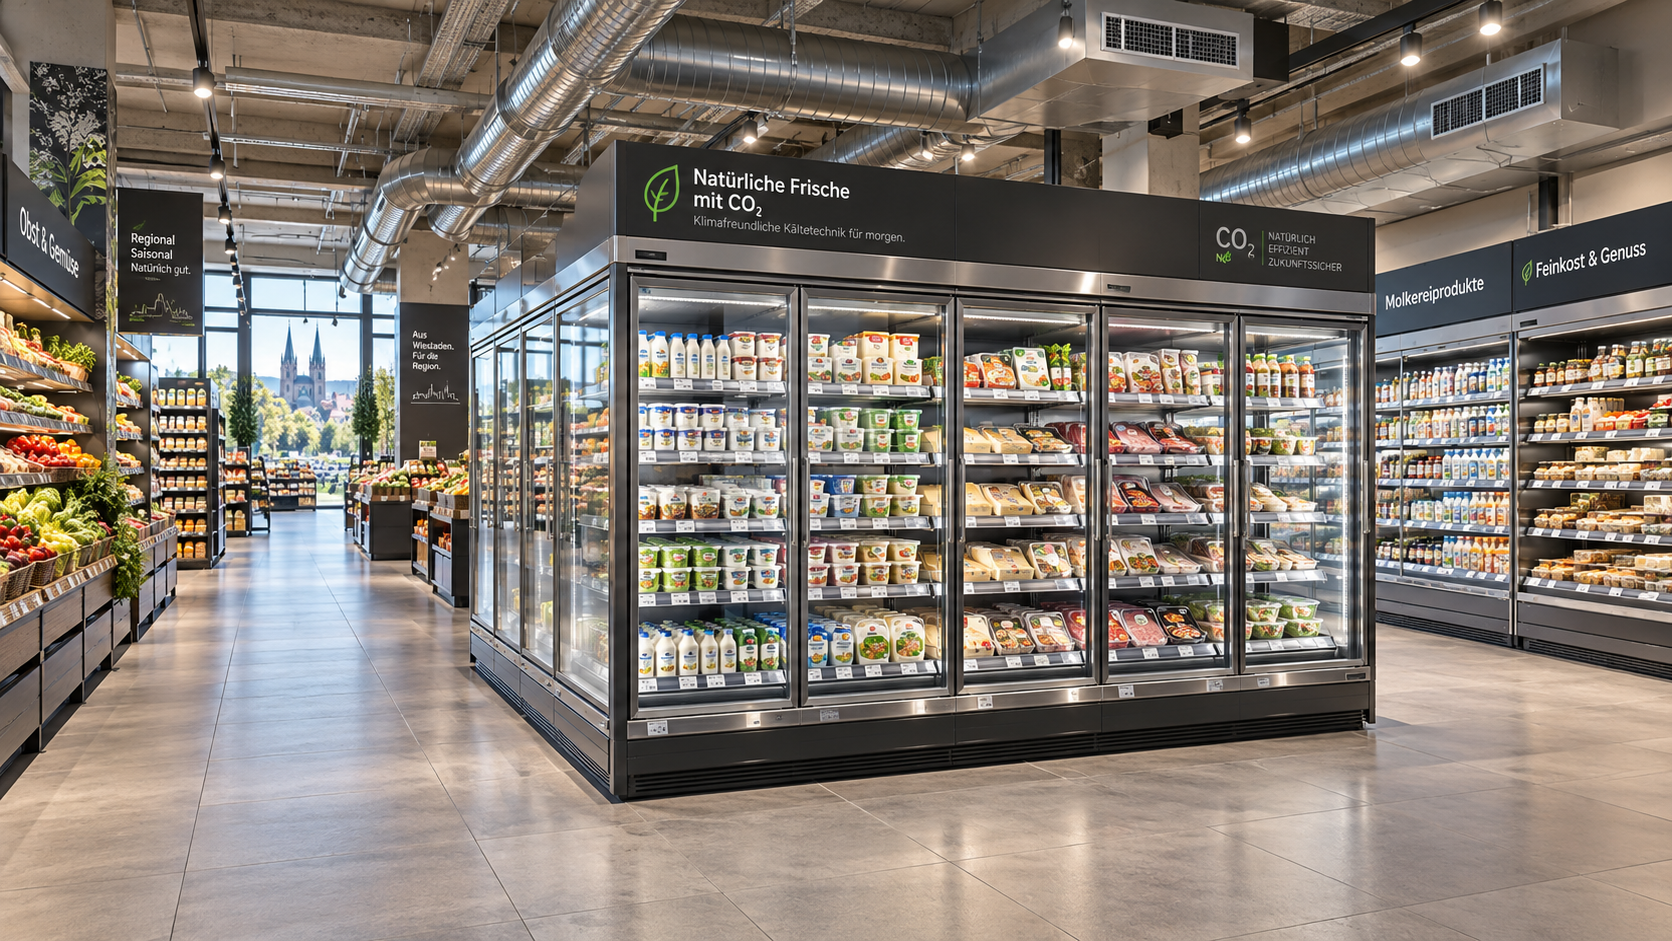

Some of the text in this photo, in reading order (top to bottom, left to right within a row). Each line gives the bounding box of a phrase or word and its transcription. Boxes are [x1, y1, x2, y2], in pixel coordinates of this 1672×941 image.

[693, 168, 850, 199] Natürliche Frische
[693, 192, 723, 209] mit
[20, 206, 40, 248] Obst
[41, 226, 48, 255] &
[693, 215, 905, 244] Klimafreundliche Kältetechnik für morgen.
[1268, 231, 1316, 244] NATÜRLICH
[131, 232, 175, 247] Regional
[130, 247, 173, 260] Saisonal
[1535, 242, 1646, 278] Feinkost & Genuss
[174, 265, 191, 277] gut.
[1268, 257, 1342, 272] ZUKUNFTSSICHER
[1385, 277, 1484, 310] Molkereiprodukte
[412, 330, 427, 339] Aus
